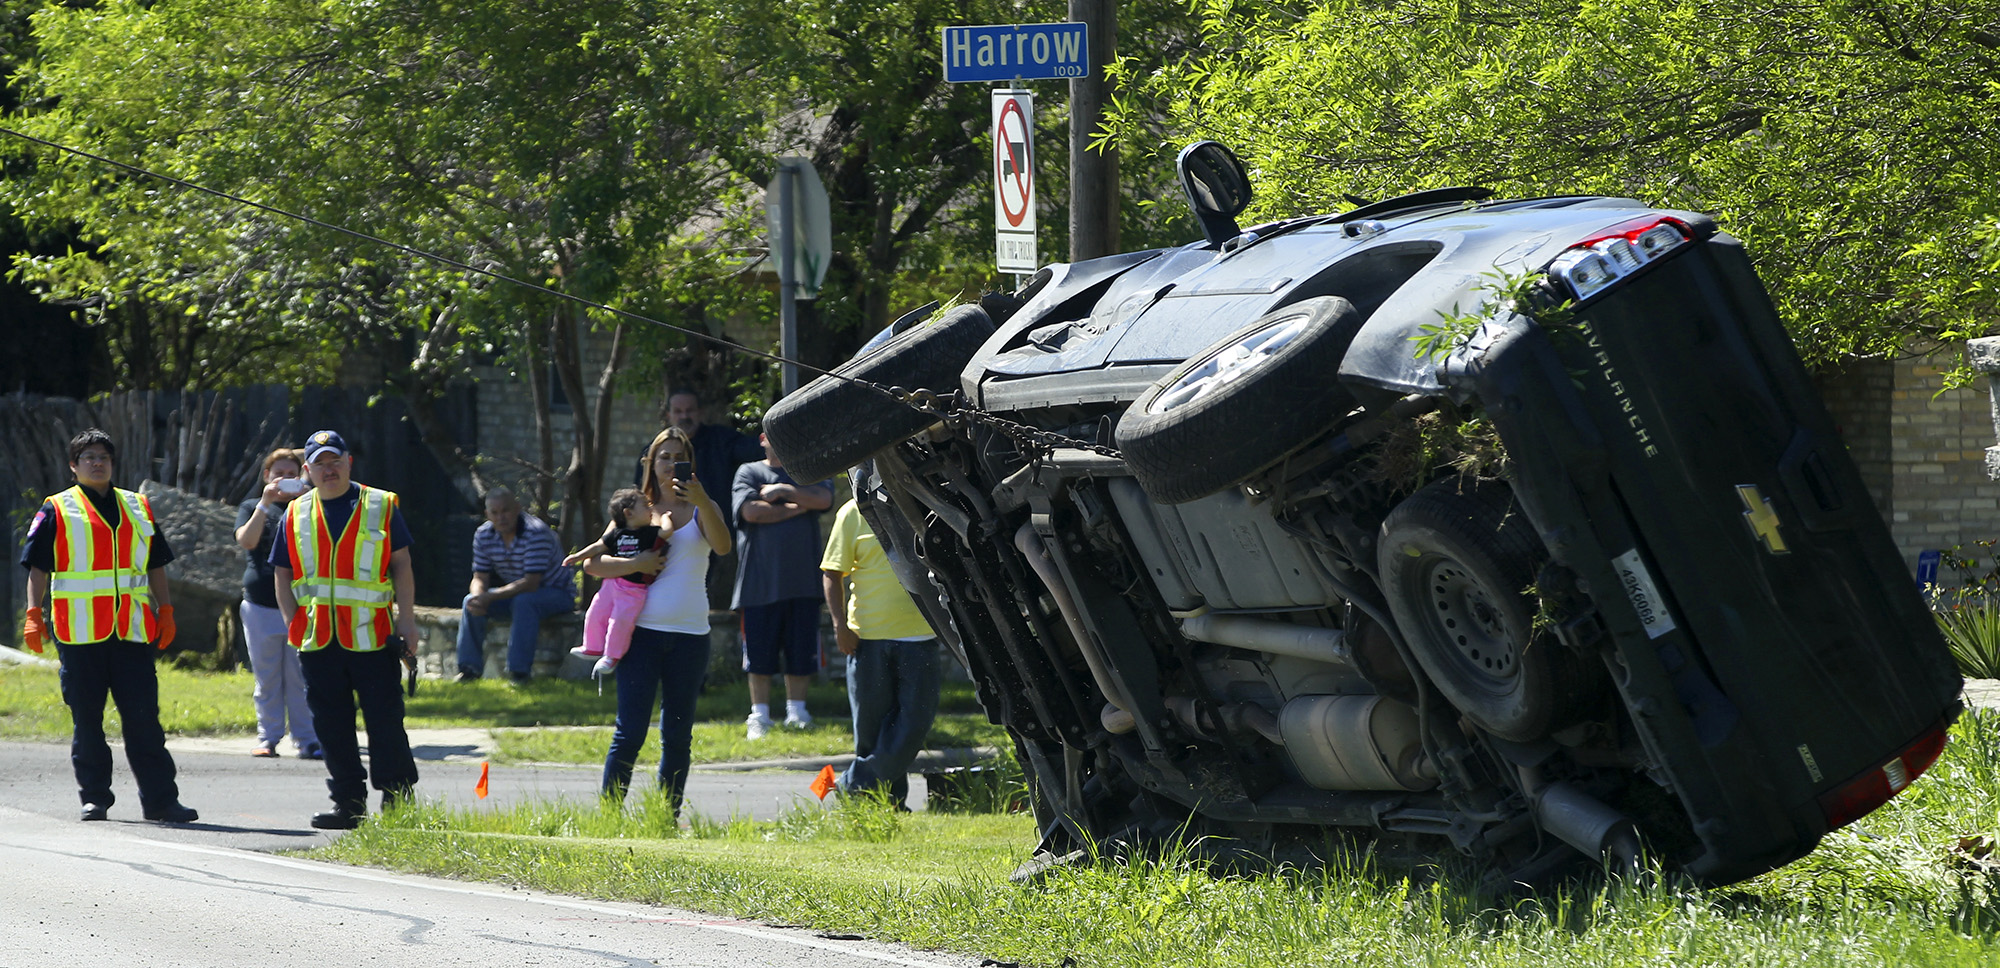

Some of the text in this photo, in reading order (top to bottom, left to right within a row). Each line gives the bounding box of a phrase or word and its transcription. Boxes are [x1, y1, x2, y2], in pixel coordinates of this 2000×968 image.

[952, 29, 1080, 67] Harrow
[1053, 66, 1075, 76] 100
[1577, 320, 1658, 458] AVALANCHE
[1622, 569, 1656, 625] 43K6068
